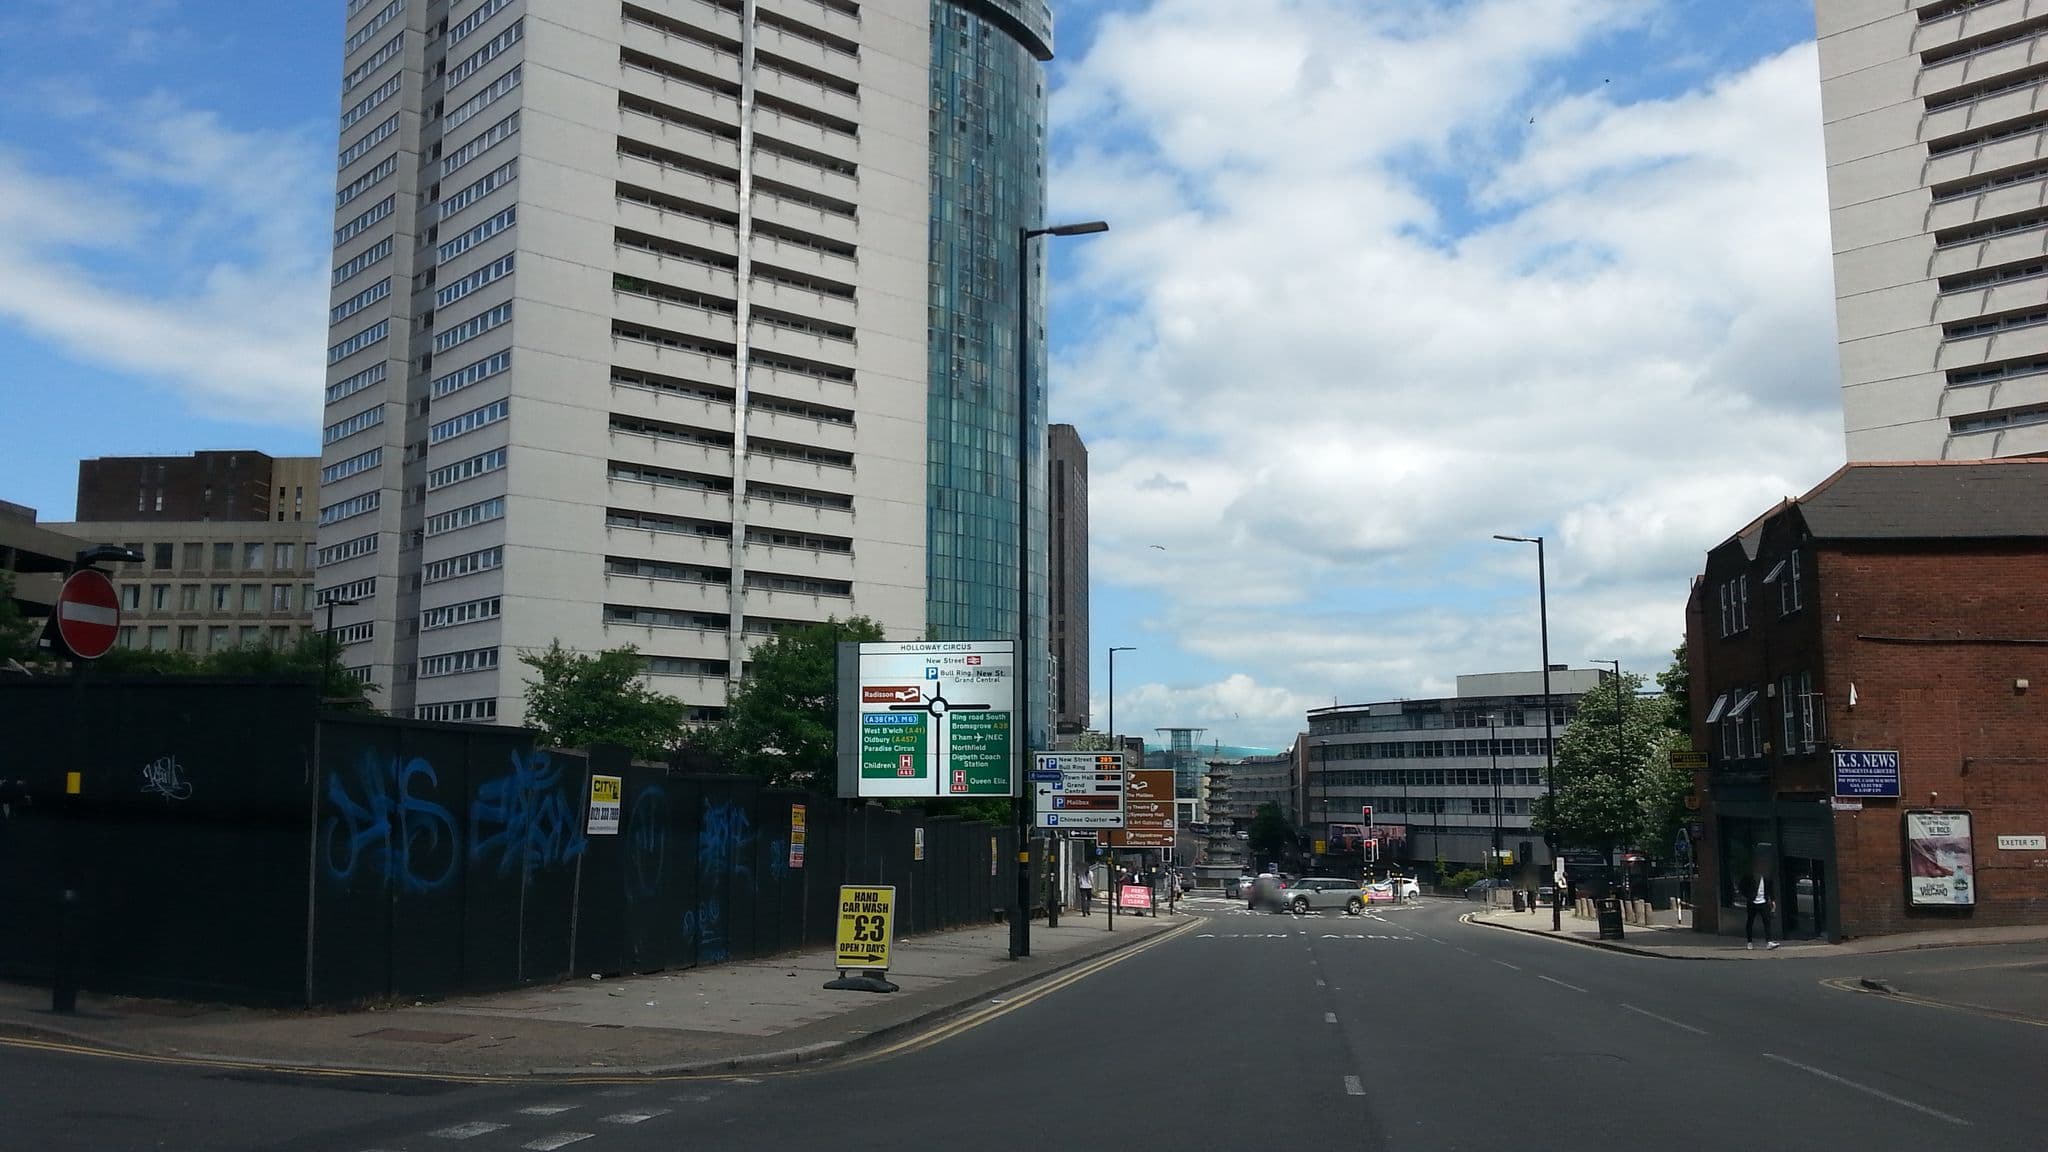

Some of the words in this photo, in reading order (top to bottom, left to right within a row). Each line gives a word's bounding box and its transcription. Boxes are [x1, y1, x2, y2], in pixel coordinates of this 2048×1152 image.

[1837, 754, 1860, 767] K.S.
[1863, 754, 1896, 768] NEWS
[594, 780, 613, 792] CITY
[854, 892, 878, 902] HAND
[842, 902, 860, 912] CAR
[862, 903, 889, 913] WASH
[854, 915, 884, 942] £3
[840, 943, 859, 952] OPEN
[861, 943, 864, 952] 7
[866, 944, 886, 953] DAYS
